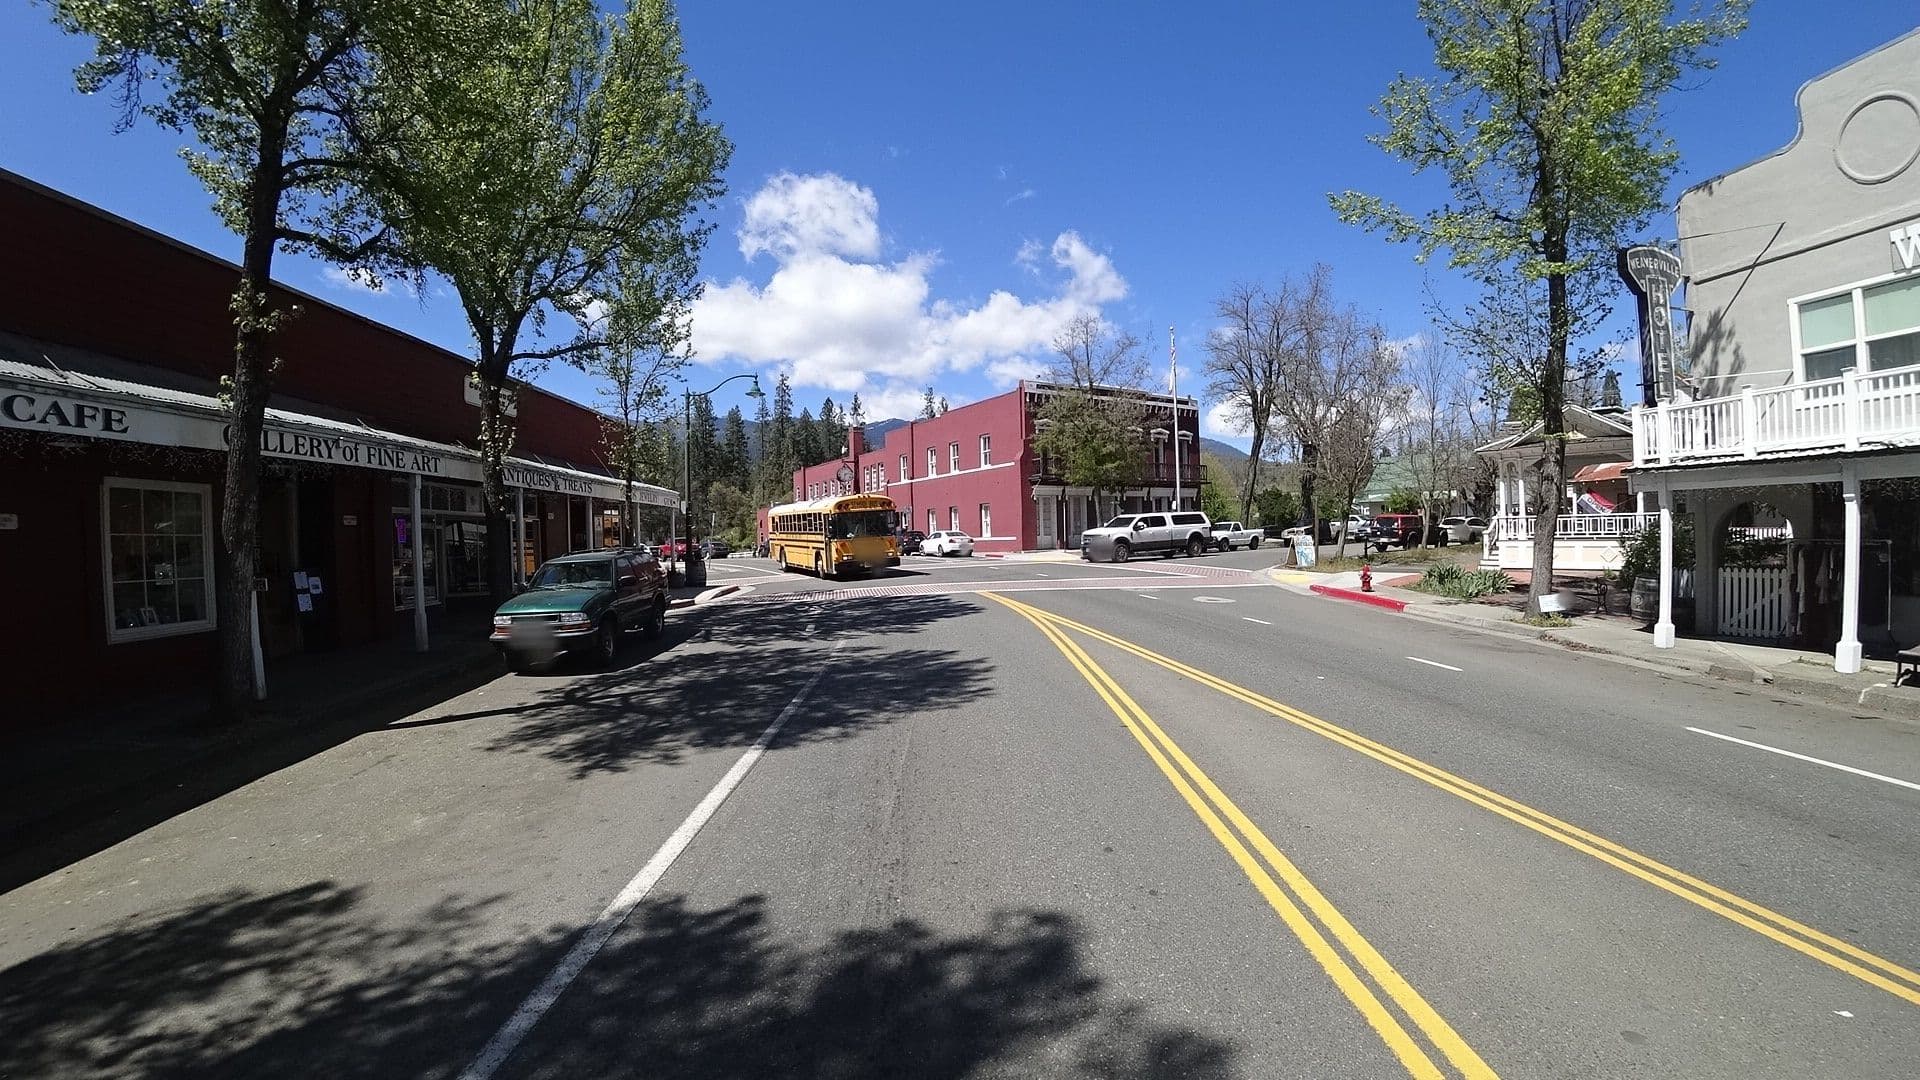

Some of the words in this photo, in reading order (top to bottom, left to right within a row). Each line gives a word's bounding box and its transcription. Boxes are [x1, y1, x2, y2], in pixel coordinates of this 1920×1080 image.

[1630, 256, 1679, 278] WEAVERVILLE
[1651, 283, 1672, 397] HOTEL
[1, 394, 129, 433] CAFE
[223, 424, 336, 459] LLERY
[342, 442, 360, 463] of
[367, 446, 405, 469] FINE
[411, 454, 440, 473] ART
[502, 468, 550, 487] ANTIQUES
[563, 479, 593, 494] TREATS
